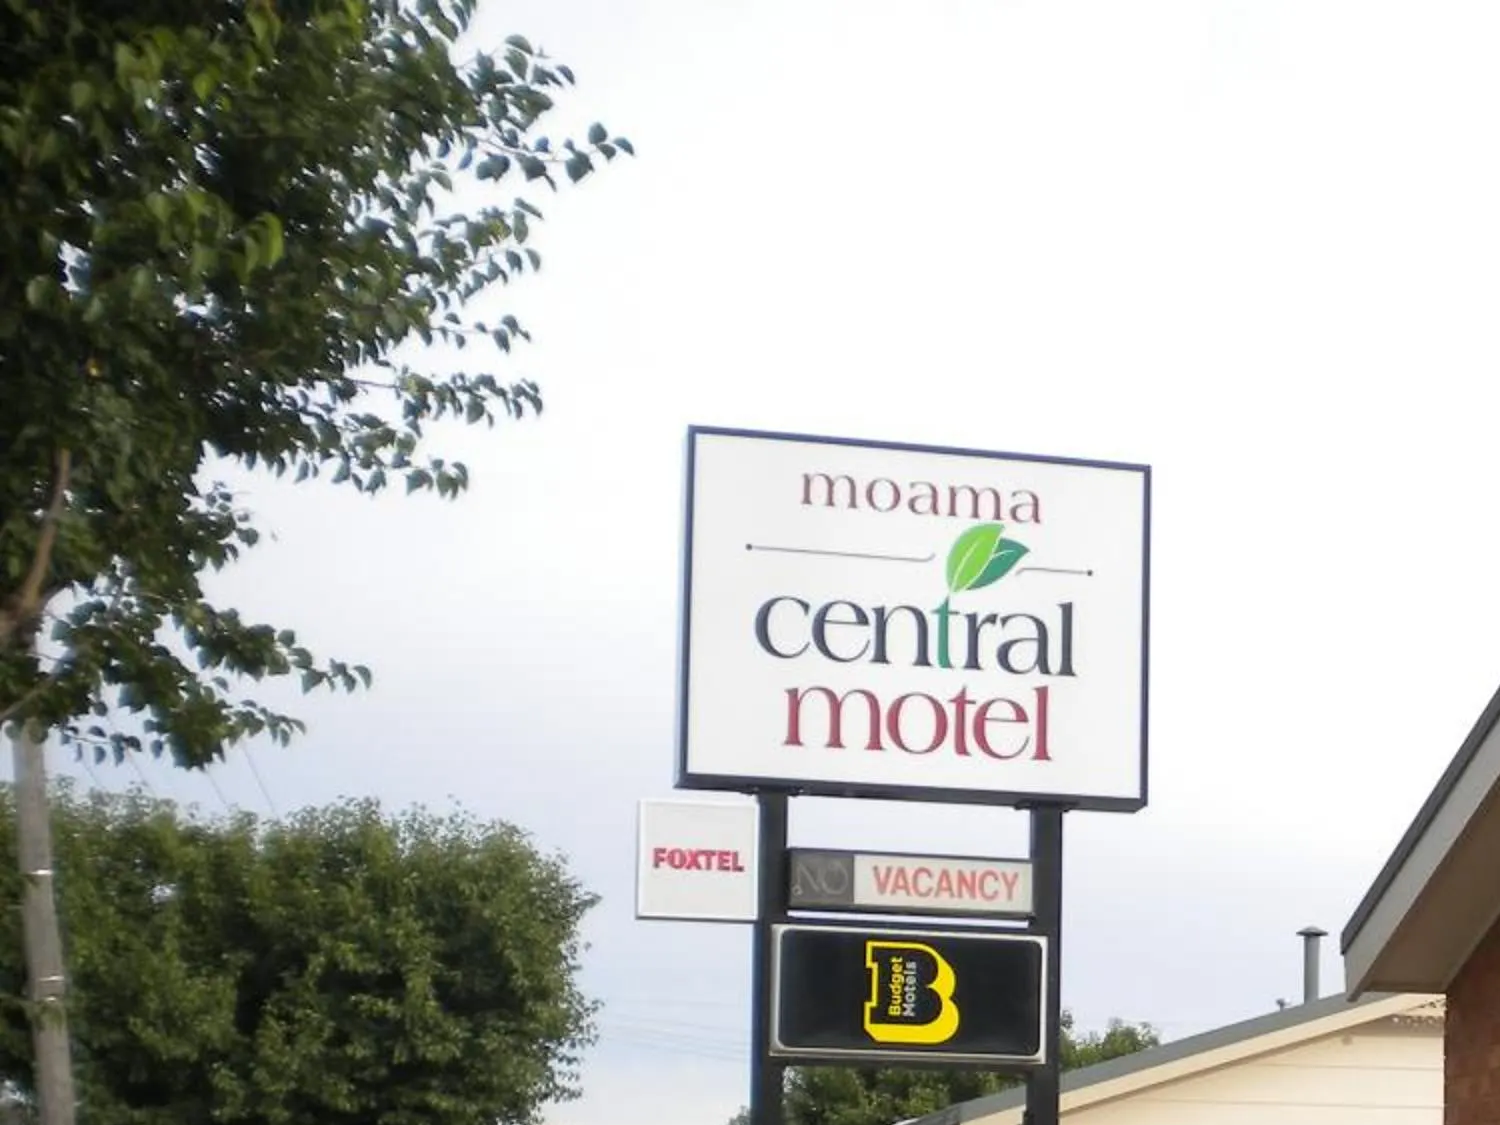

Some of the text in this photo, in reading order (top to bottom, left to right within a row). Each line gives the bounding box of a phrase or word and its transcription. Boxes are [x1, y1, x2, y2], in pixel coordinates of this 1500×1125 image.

[800, 471, 1042, 524] moama
[754, 594, 1077, 676] central
[783, 684, 1053, 762] motel
[653, 847, 745, 872] FOXTEL
[872, 865, 1019, 901] VACANCY
[888, 957, 904, 1016] Budget
[902, 961, 917, 1017] Motels
